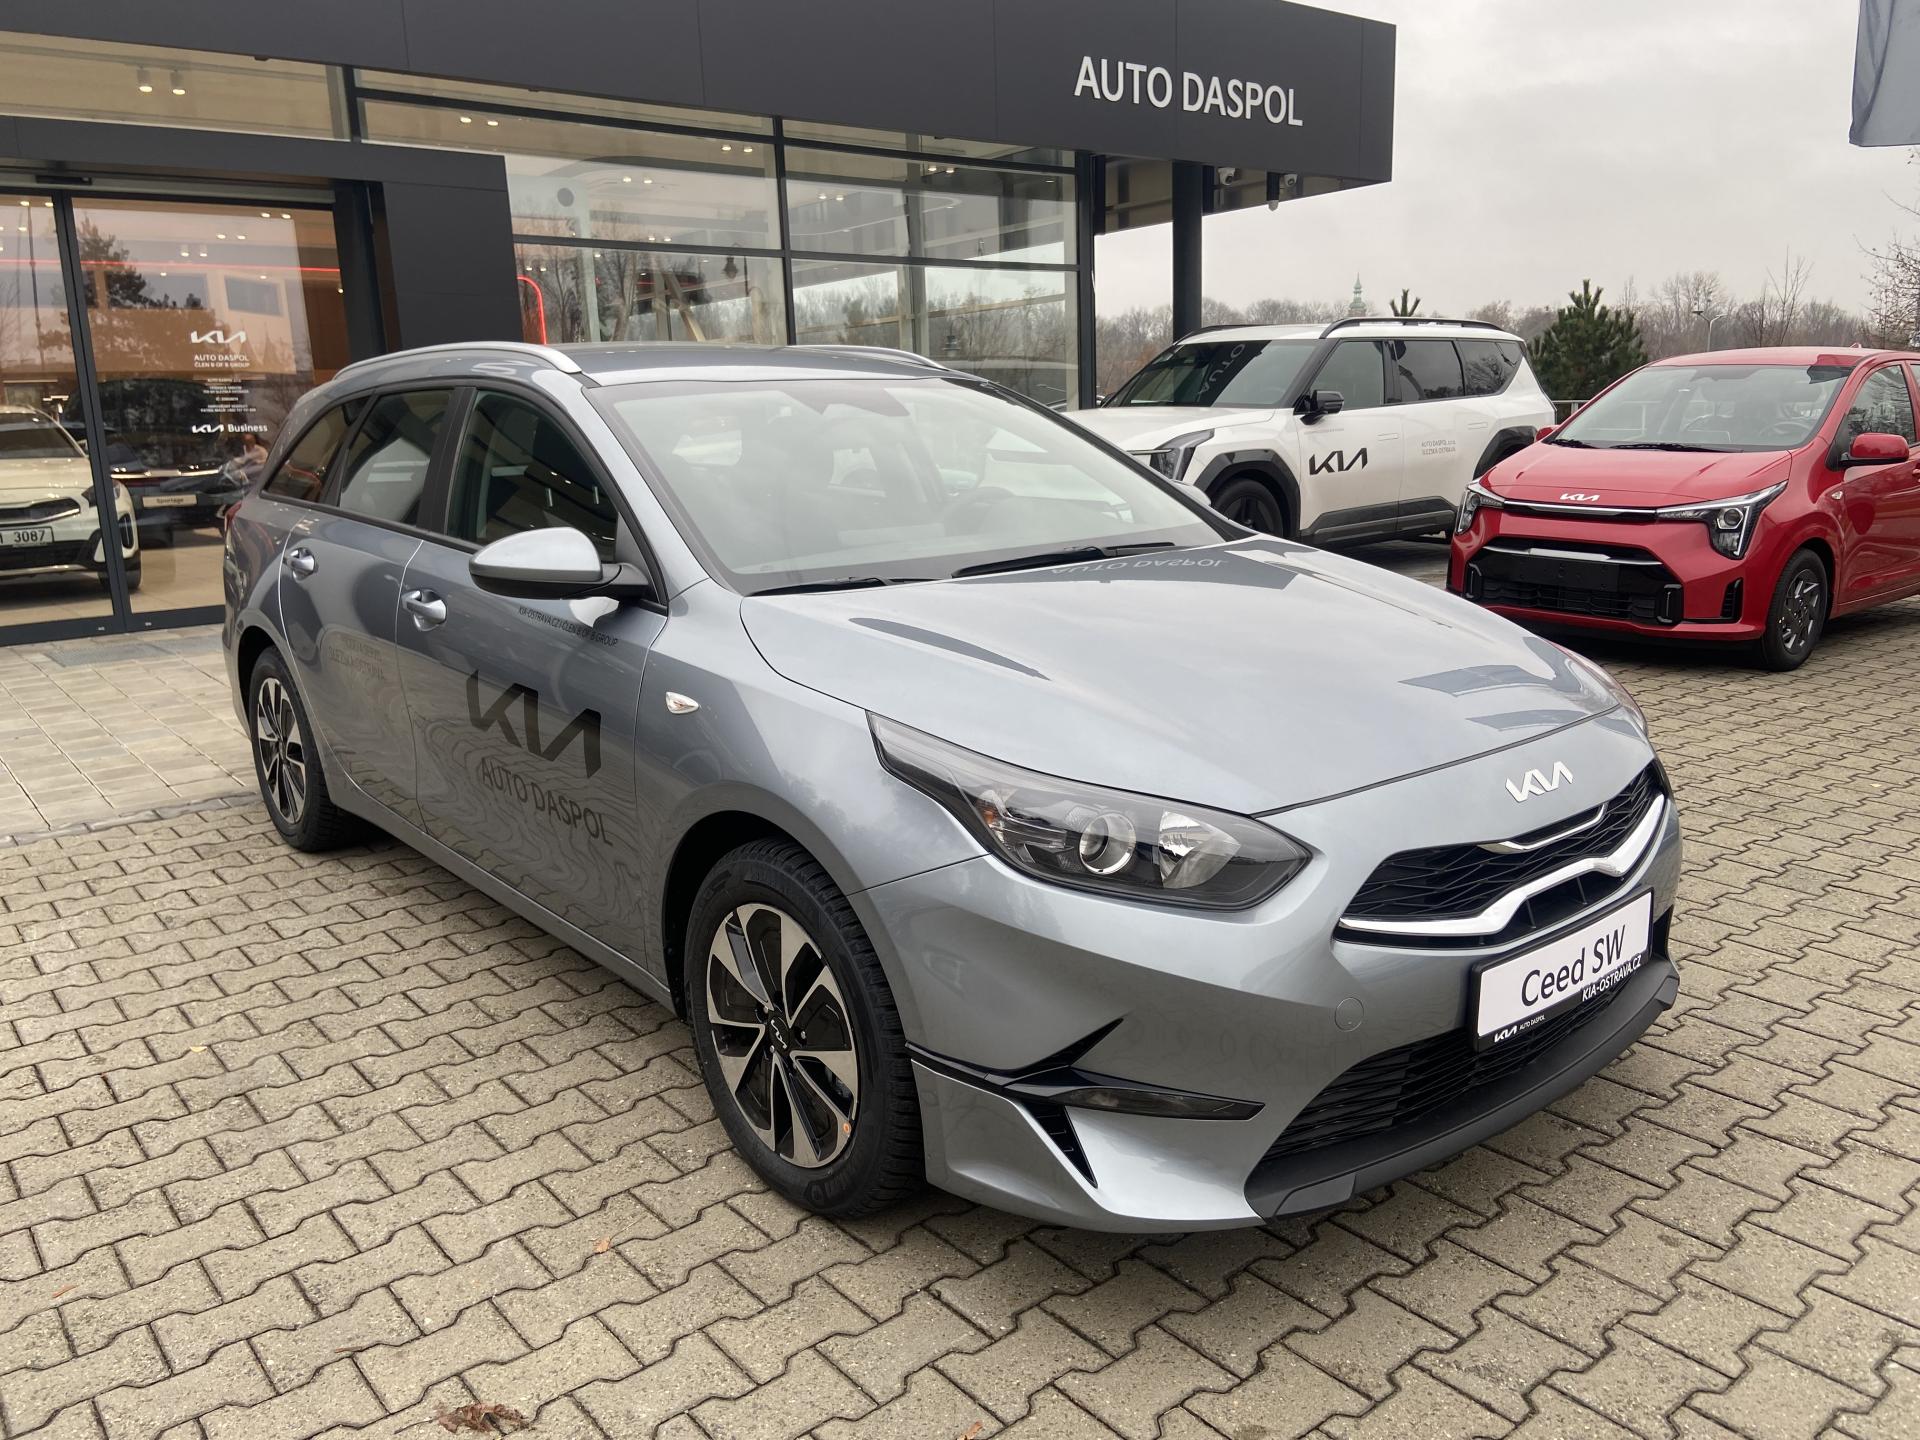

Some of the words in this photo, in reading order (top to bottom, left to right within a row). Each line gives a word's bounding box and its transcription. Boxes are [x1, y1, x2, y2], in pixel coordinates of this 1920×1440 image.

[1074, 55, 1173, 108] AUTO
[1183, 71, 1304, 126] DASPOL
[190, 330, 247, 344] KIA
[191, 423, 225, 433] KIA
[227, 423, 268, 433] Business
[1309, 447, 1368, 476] KIA
[1560, 493, 1600, 501] KIA
[13, 529, 46, 544] 3087
[466, 669, 602, 779] KIA
[1505, 760, 1574, 803] KIA
[481, 756, 528, 803] AUTO
[531, 781, 614, 847] DASPOL
[1521, 946, 1586, 1007] Ceed
[1592, 923, 1626, 974] SW
[1582, 954, 1642, 1002] KIA-OSTRAVA.CZ
[1494, 1025, 1518, 1043] KIA
[1519, 1021, 1531, 1030] AUTO
[1530, 1014, 1546, 1026] DASPOL
